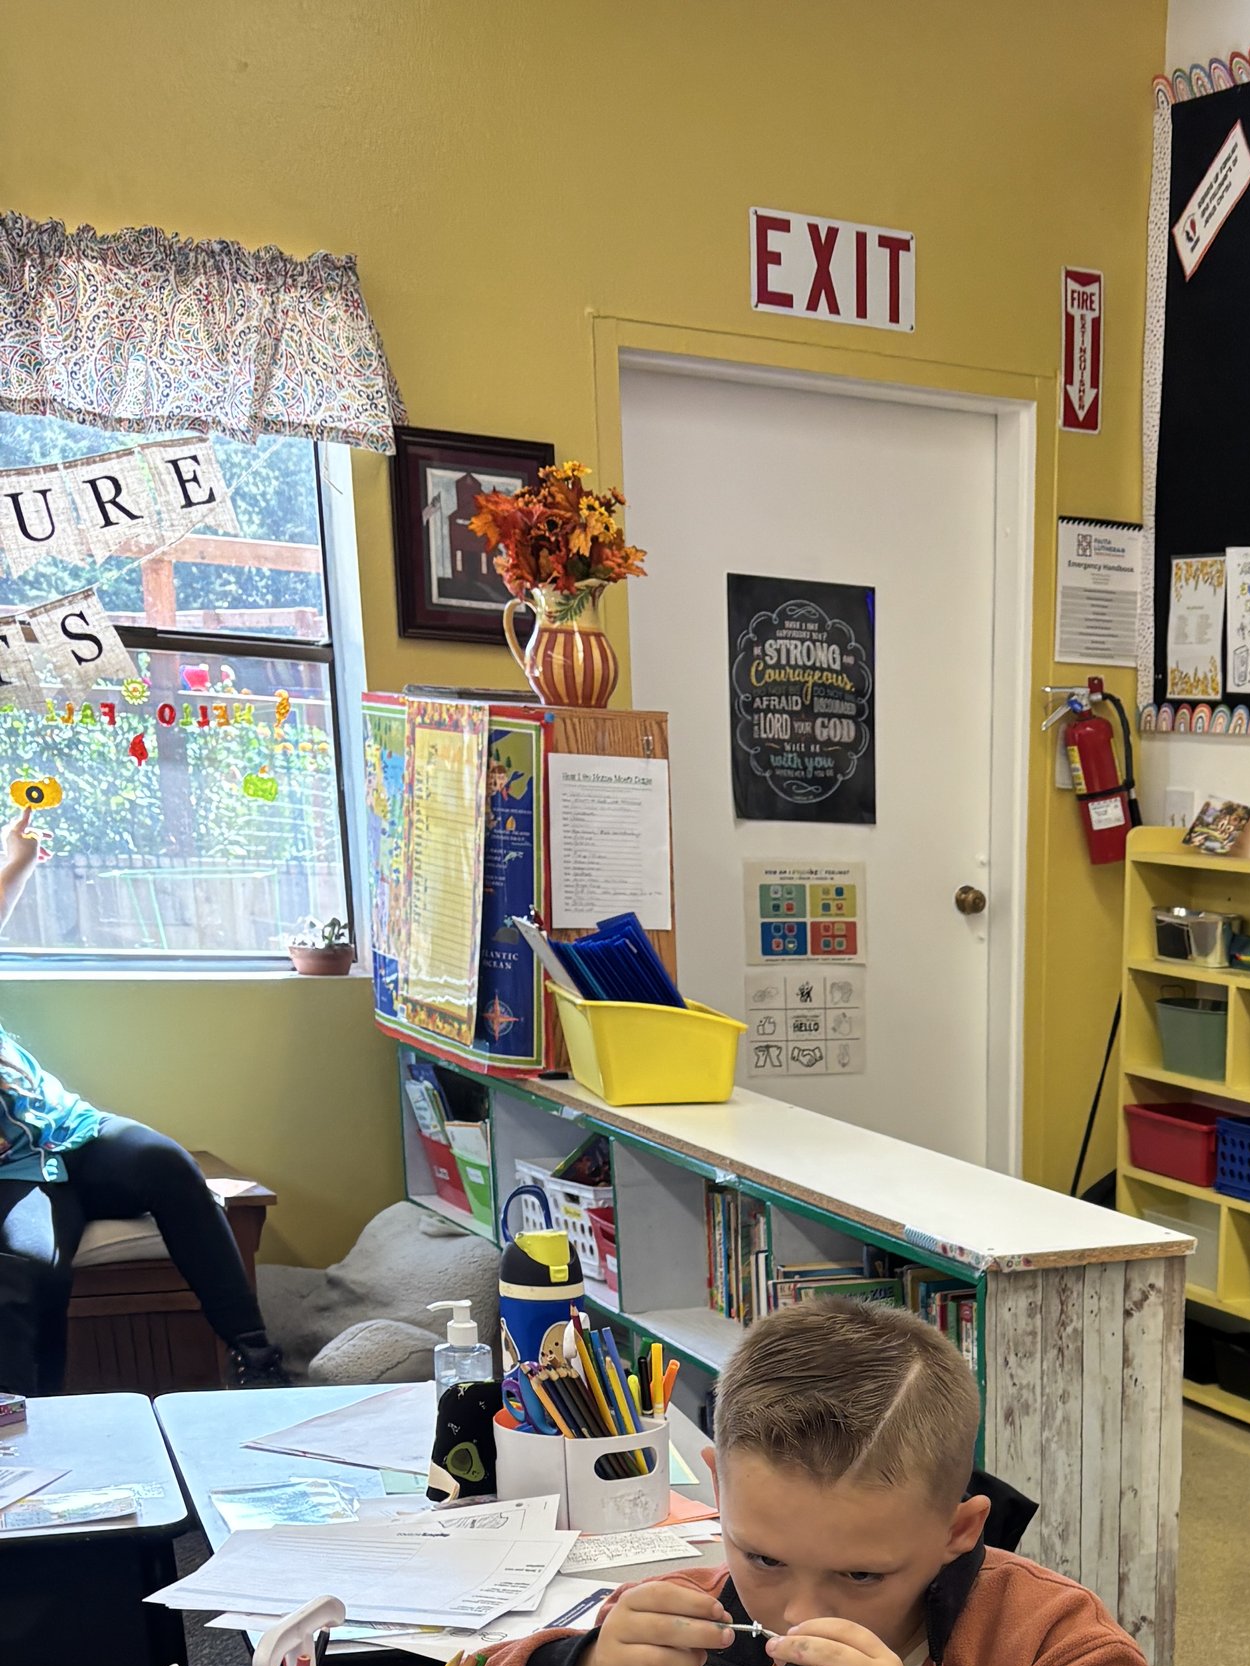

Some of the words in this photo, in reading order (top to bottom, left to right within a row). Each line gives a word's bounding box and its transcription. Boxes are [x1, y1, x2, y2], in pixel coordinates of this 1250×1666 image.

[757, 214, 911, 324] EXIT
[1070, 289, 1096, 312] FIRE
[1077, 313, 1087, 412] EXTINGUISHER
[4, 455, 216, 542] URE
[764, 639, 841, 670] STRONG
[753, 696, 801, 711] AFRAID
[760, 712, 791, 739] LORD
[814, 717, 856, 743] GOD
[770, 753, 802, 769] with
[805, 754, 835, 778] you
[792, 1022, 820, 1033] HELLO
